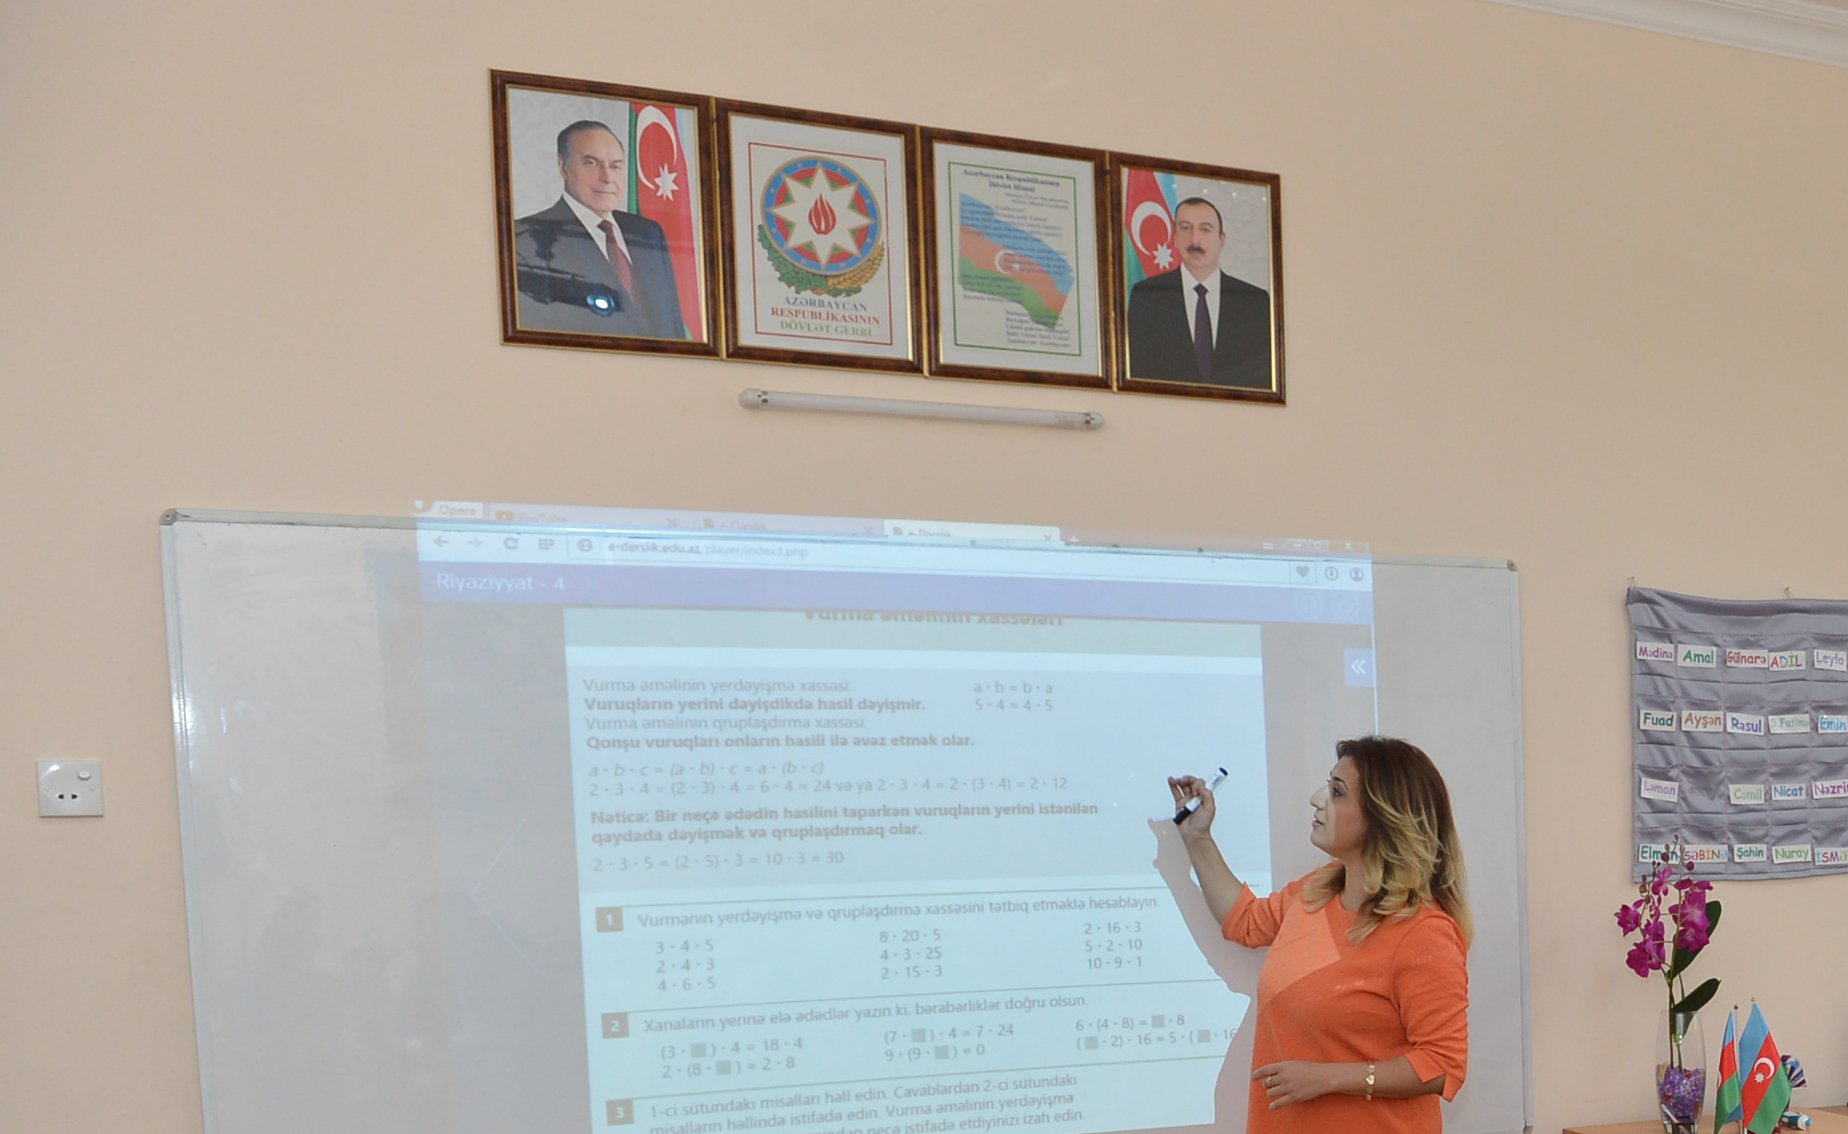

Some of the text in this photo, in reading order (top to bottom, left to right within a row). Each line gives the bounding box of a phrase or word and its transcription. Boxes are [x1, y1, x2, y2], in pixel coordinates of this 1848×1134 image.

[785, 296, 867, 311] AZƏRBAYCAN
[780, 320, 832, 334] DÖVLƏT
[440, 504, 476, 517] Opera
[436, 572, 533, 591] Riyaziyyat
[554, 577, 565, 590] 4
[1639, 646, 1673, 659] Mədinə
[1683, 650, 1714, 663] Amal
[1771, 652, 1803, 668] ADİL
[1816, 651, 1845, 667] Leyla
[1643, 712, 1674, 727] Fuad
[1685, 712, 1721, 729] Ayşən
[1731, 717, 1762, 733] Rəsul
[1644, 780, 1676, 796] Ləman
[1734, 788, 1762, 800] Cəmil
[1774, 786, 1804, 797] Nicat
[1641, 845, 1678, 860] Elmn
[1737, 847, 1764, 860] Şahin
[1775, 848, 1809, 860] Nuray
